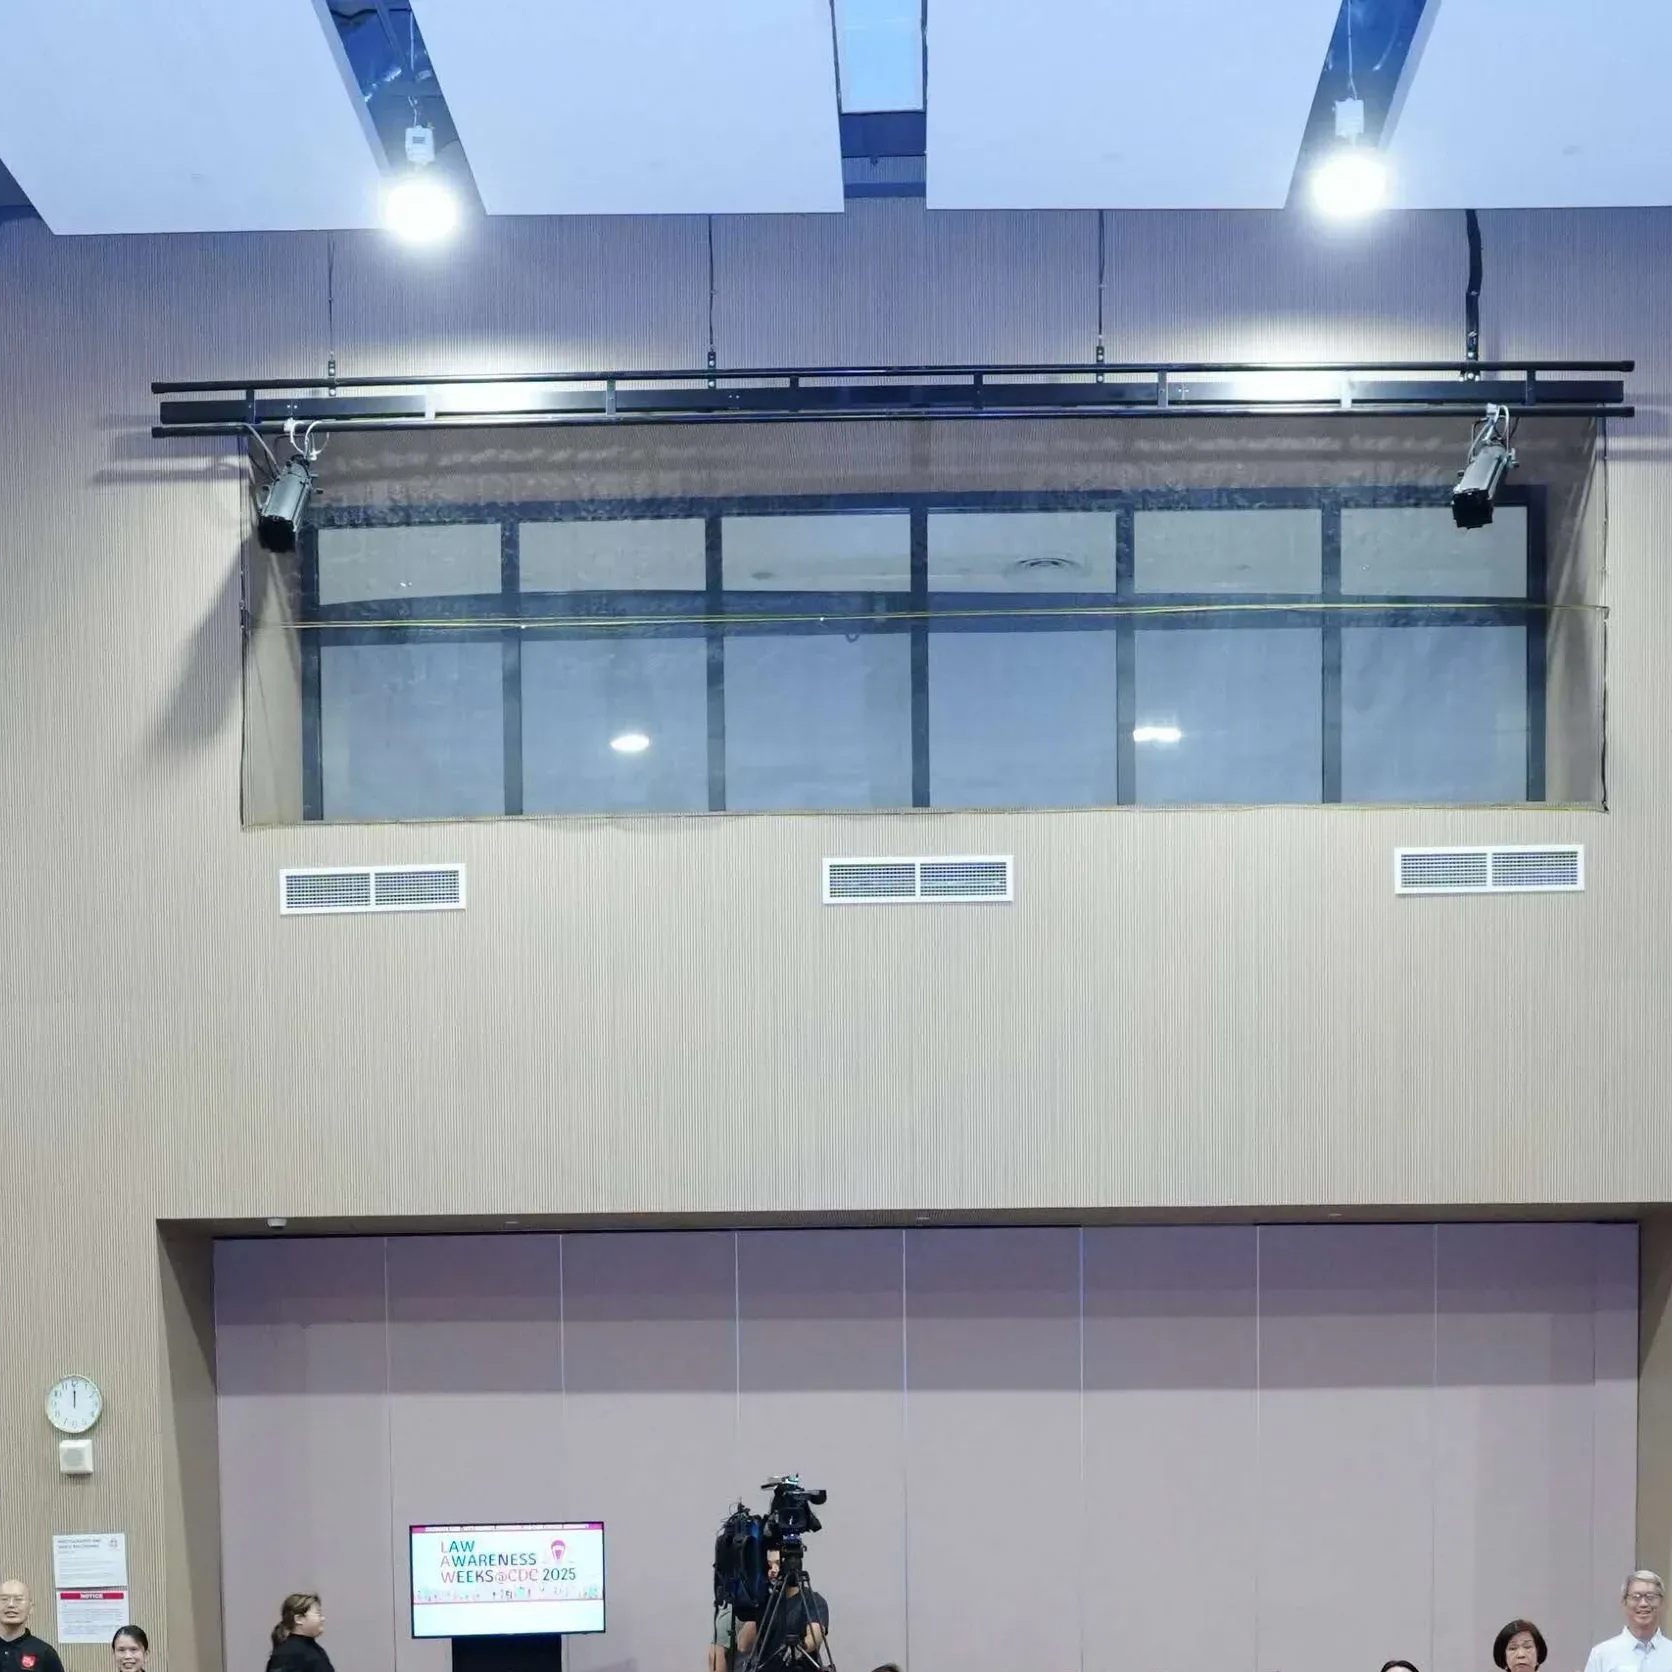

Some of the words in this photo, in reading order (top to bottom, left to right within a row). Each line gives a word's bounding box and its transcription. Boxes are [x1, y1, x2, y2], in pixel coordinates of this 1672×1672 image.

[441, 1540, 475, 1553] LAW
[440, 1553, 537, 1567] AWARENESS
[441, 1569, 538, 1584] WEEKS@CDC
[543, 1568, 576, 1581] 2025
